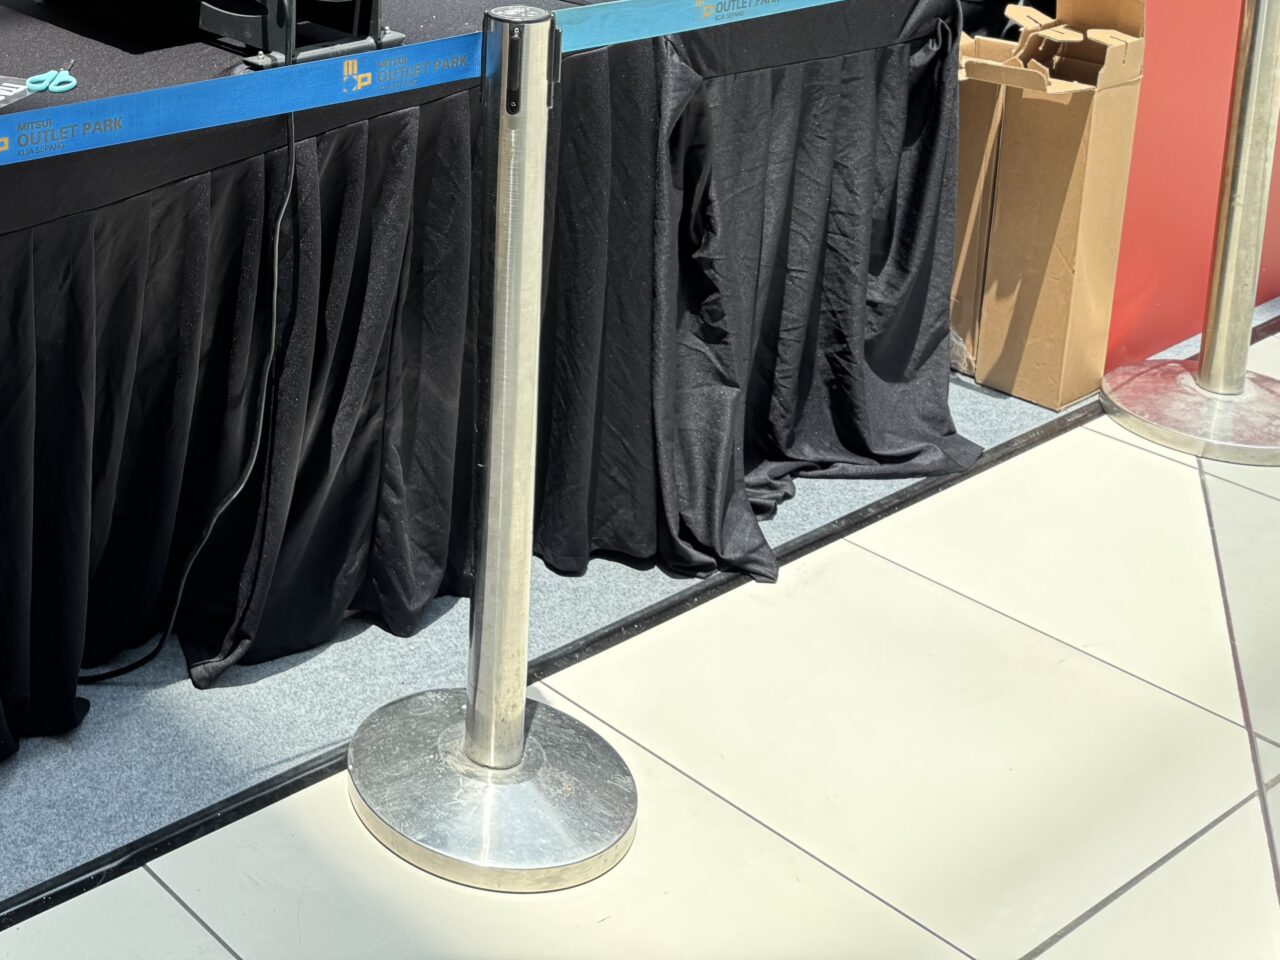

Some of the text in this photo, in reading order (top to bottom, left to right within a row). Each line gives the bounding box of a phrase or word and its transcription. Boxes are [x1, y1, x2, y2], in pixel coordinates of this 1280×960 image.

[378, 55, 468, 82] OUTLET PARK
[17, 118, 52, 132] MITSUI
[18, 116, 123, 147] OUTLET PARK
[18, 144, 65, 156] KLIA SEPANG
